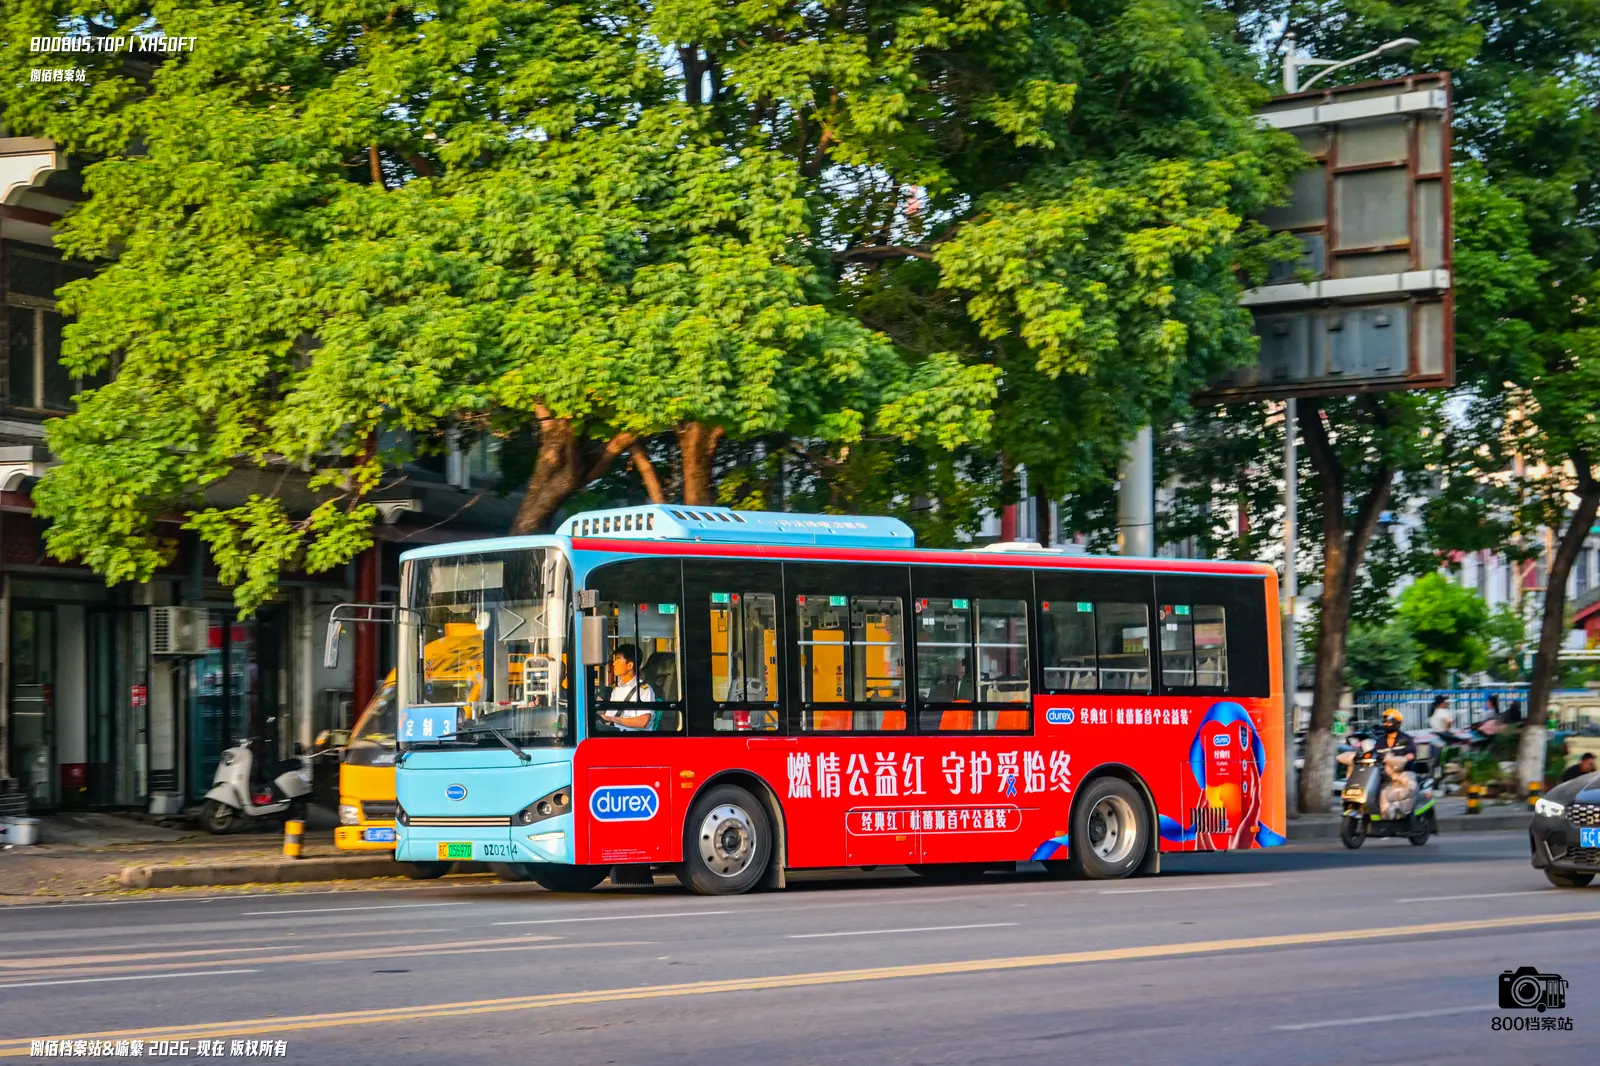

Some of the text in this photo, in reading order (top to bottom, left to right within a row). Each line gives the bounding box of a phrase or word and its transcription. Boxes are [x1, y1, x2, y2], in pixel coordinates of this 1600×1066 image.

[787, 751, 927, 799] 燃情公益红
[596, 790, 653, 815] durex
[861, 811, 898, 831] 经典红
